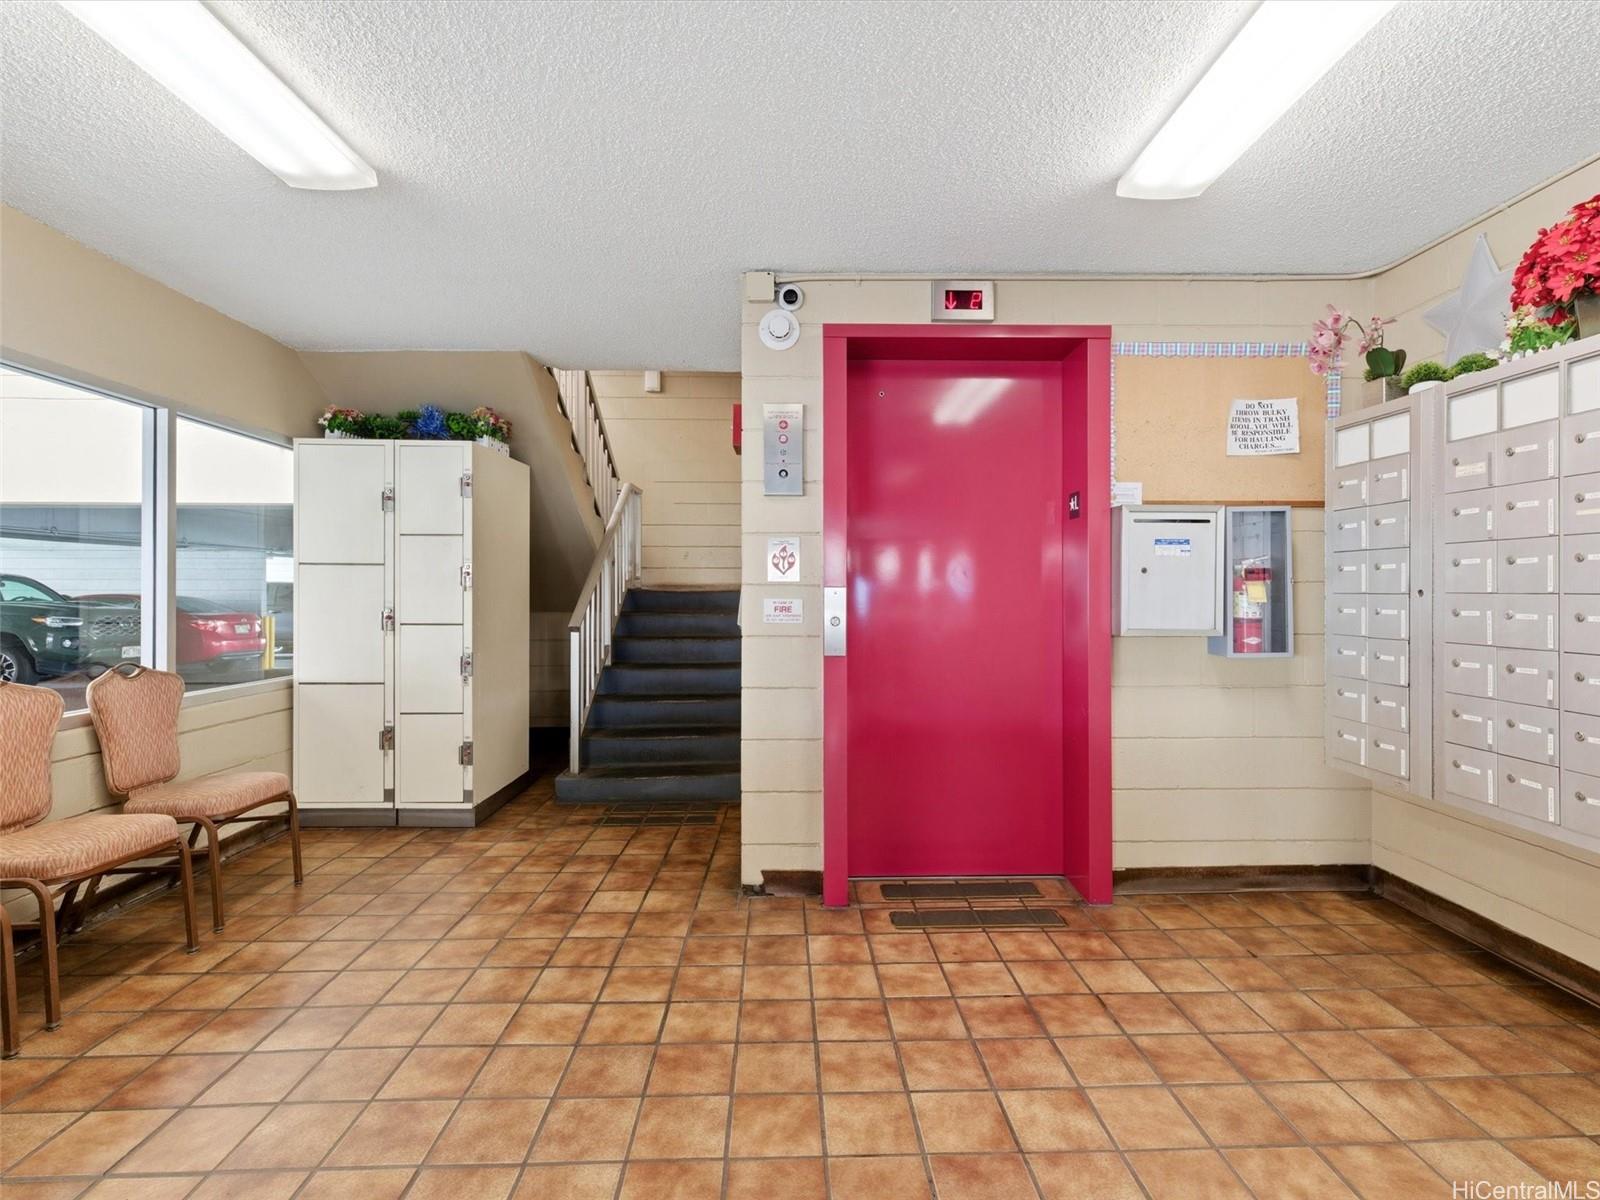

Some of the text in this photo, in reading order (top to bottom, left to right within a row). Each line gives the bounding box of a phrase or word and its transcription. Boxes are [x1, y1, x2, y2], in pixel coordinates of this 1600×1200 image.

[970, 292, 982, 309] 2
[1262, 408, 1287, 416] BULKY
[1263, 415, 1290, 423] TRASH
[1249, 435, 1286, 443] HAULING
[774, 605, 793, 613] FIRE
